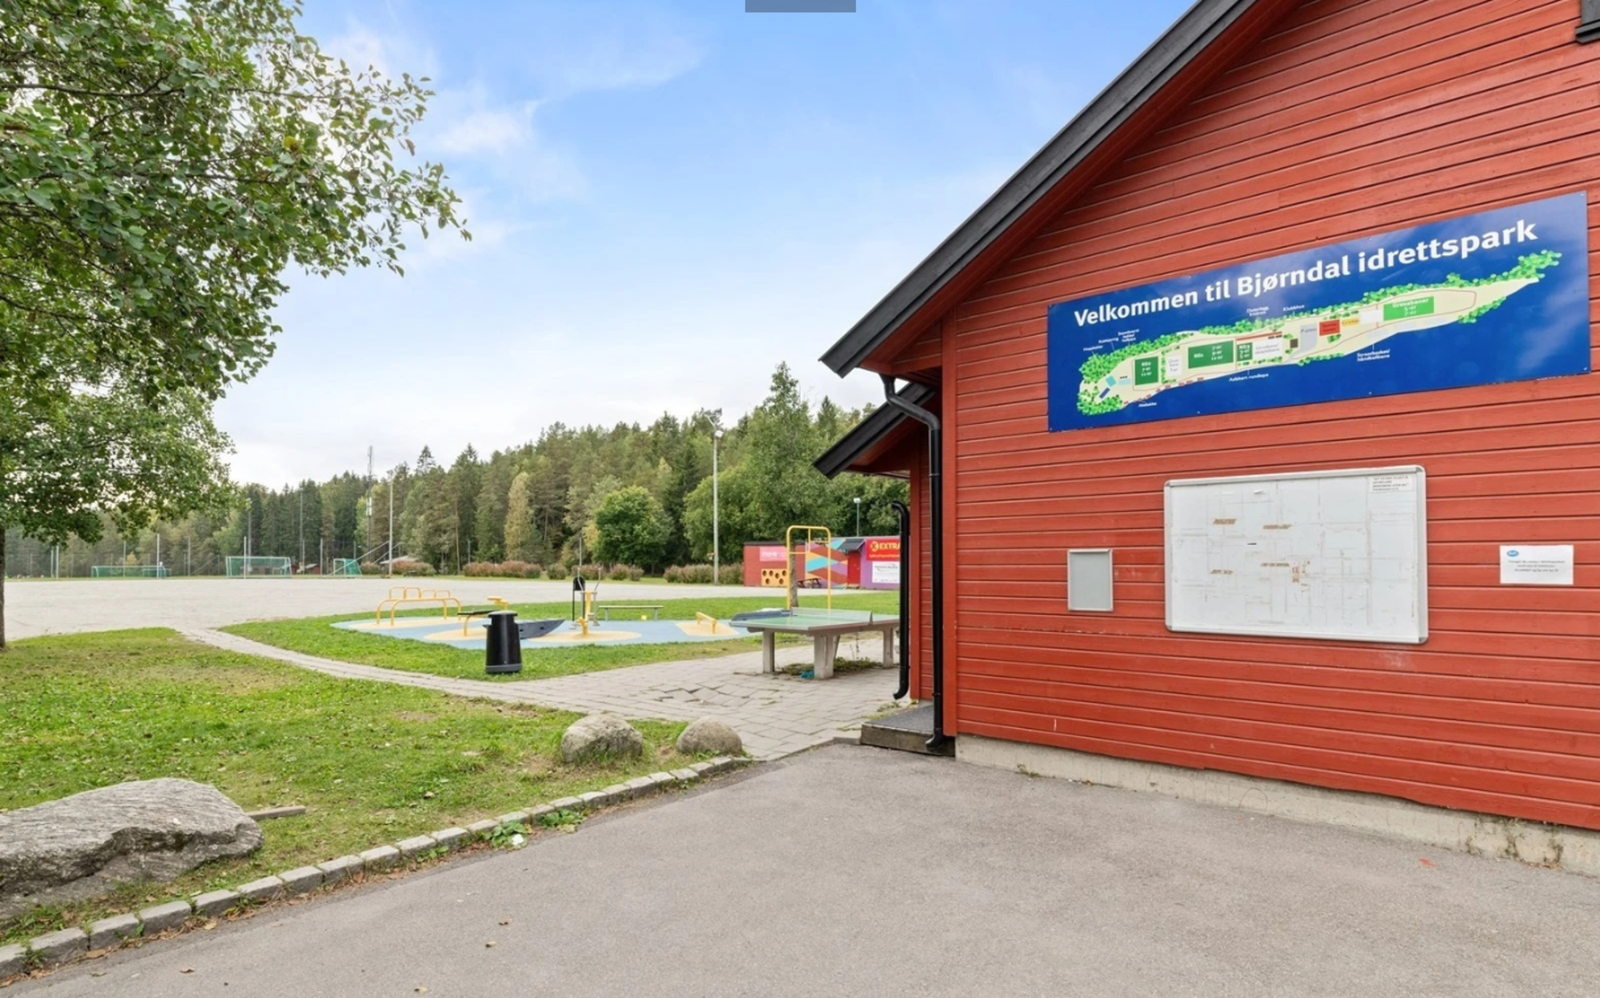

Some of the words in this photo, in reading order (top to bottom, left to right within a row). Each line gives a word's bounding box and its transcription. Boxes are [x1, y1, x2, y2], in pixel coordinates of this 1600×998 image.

[1074, 292, 1199, 327] Velkommen
[1205, 278, 1231, 302] til
[1237, 255, 1351, 298] Bjørndal
[1358, 219, 1539, 273] idrettspark
